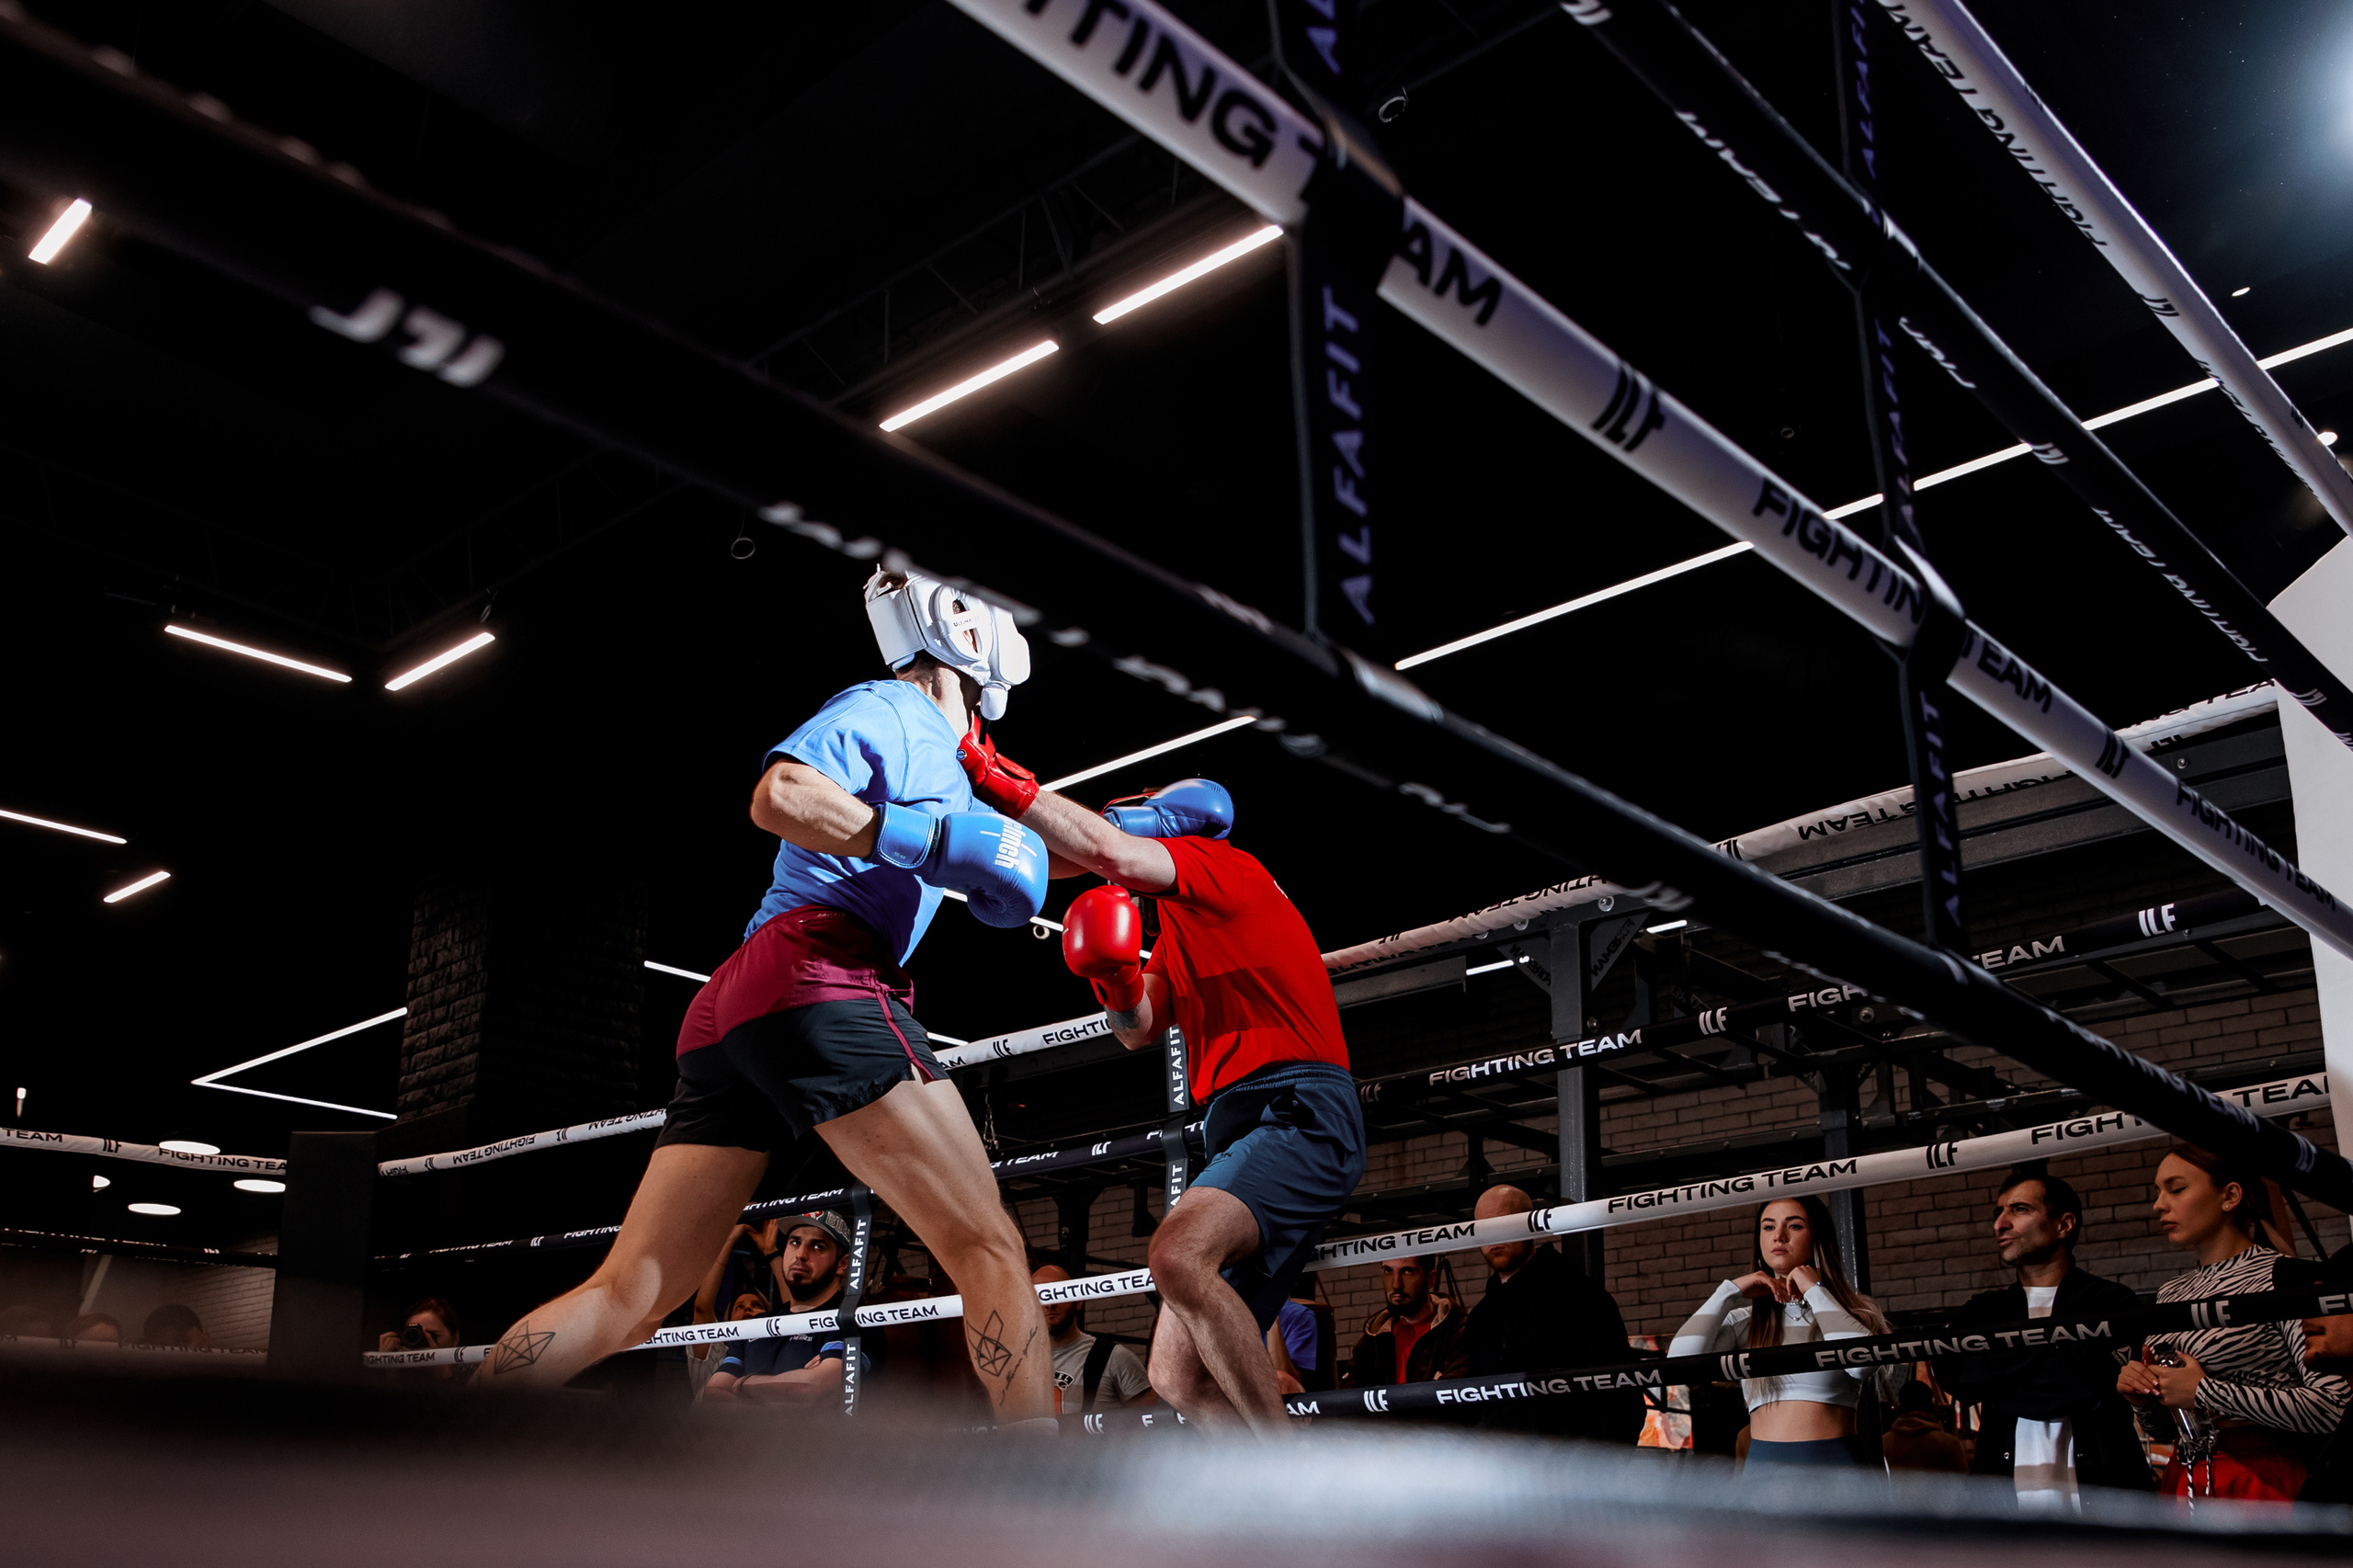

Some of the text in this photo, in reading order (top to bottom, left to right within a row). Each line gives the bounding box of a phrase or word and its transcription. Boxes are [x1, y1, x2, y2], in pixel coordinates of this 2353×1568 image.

[1322, 284, 1375, 625] ALFAFIT
[1751, 478, 1927, 625] FIGHTIN
[1796, 808, 1894, 842] TEAM
[1169, 1025, 1185, 1106] ALFAFIT
[1428, 1028, 1643, 1086] FIGHTING TEAM
[4, 1128, 63, 1143] TEAM
[452, 1134, 537, 1165] FIGHTING TEAM
[158, 1148, 250, 1169] FIGHTING
[1608, 1159, 1858, 1214] FIGHTING TEAM
[1402, 1222, 1476, 1247] TEAM
[849, 1219, 867, 1290] ALFAFIT
[698, 1325, 740, 1340] TEAM
[808, 1304, 938, 1331] FIGING TEAM
[406, 1352, 436, 1362] TEAM
[1814, 1320, 2112, 1368] FIGHTING TEAM
[845, 1343, 857, 1416] ALFAFIT
[1436, 1369, 1664, 1405] FIGHTING TEAM
